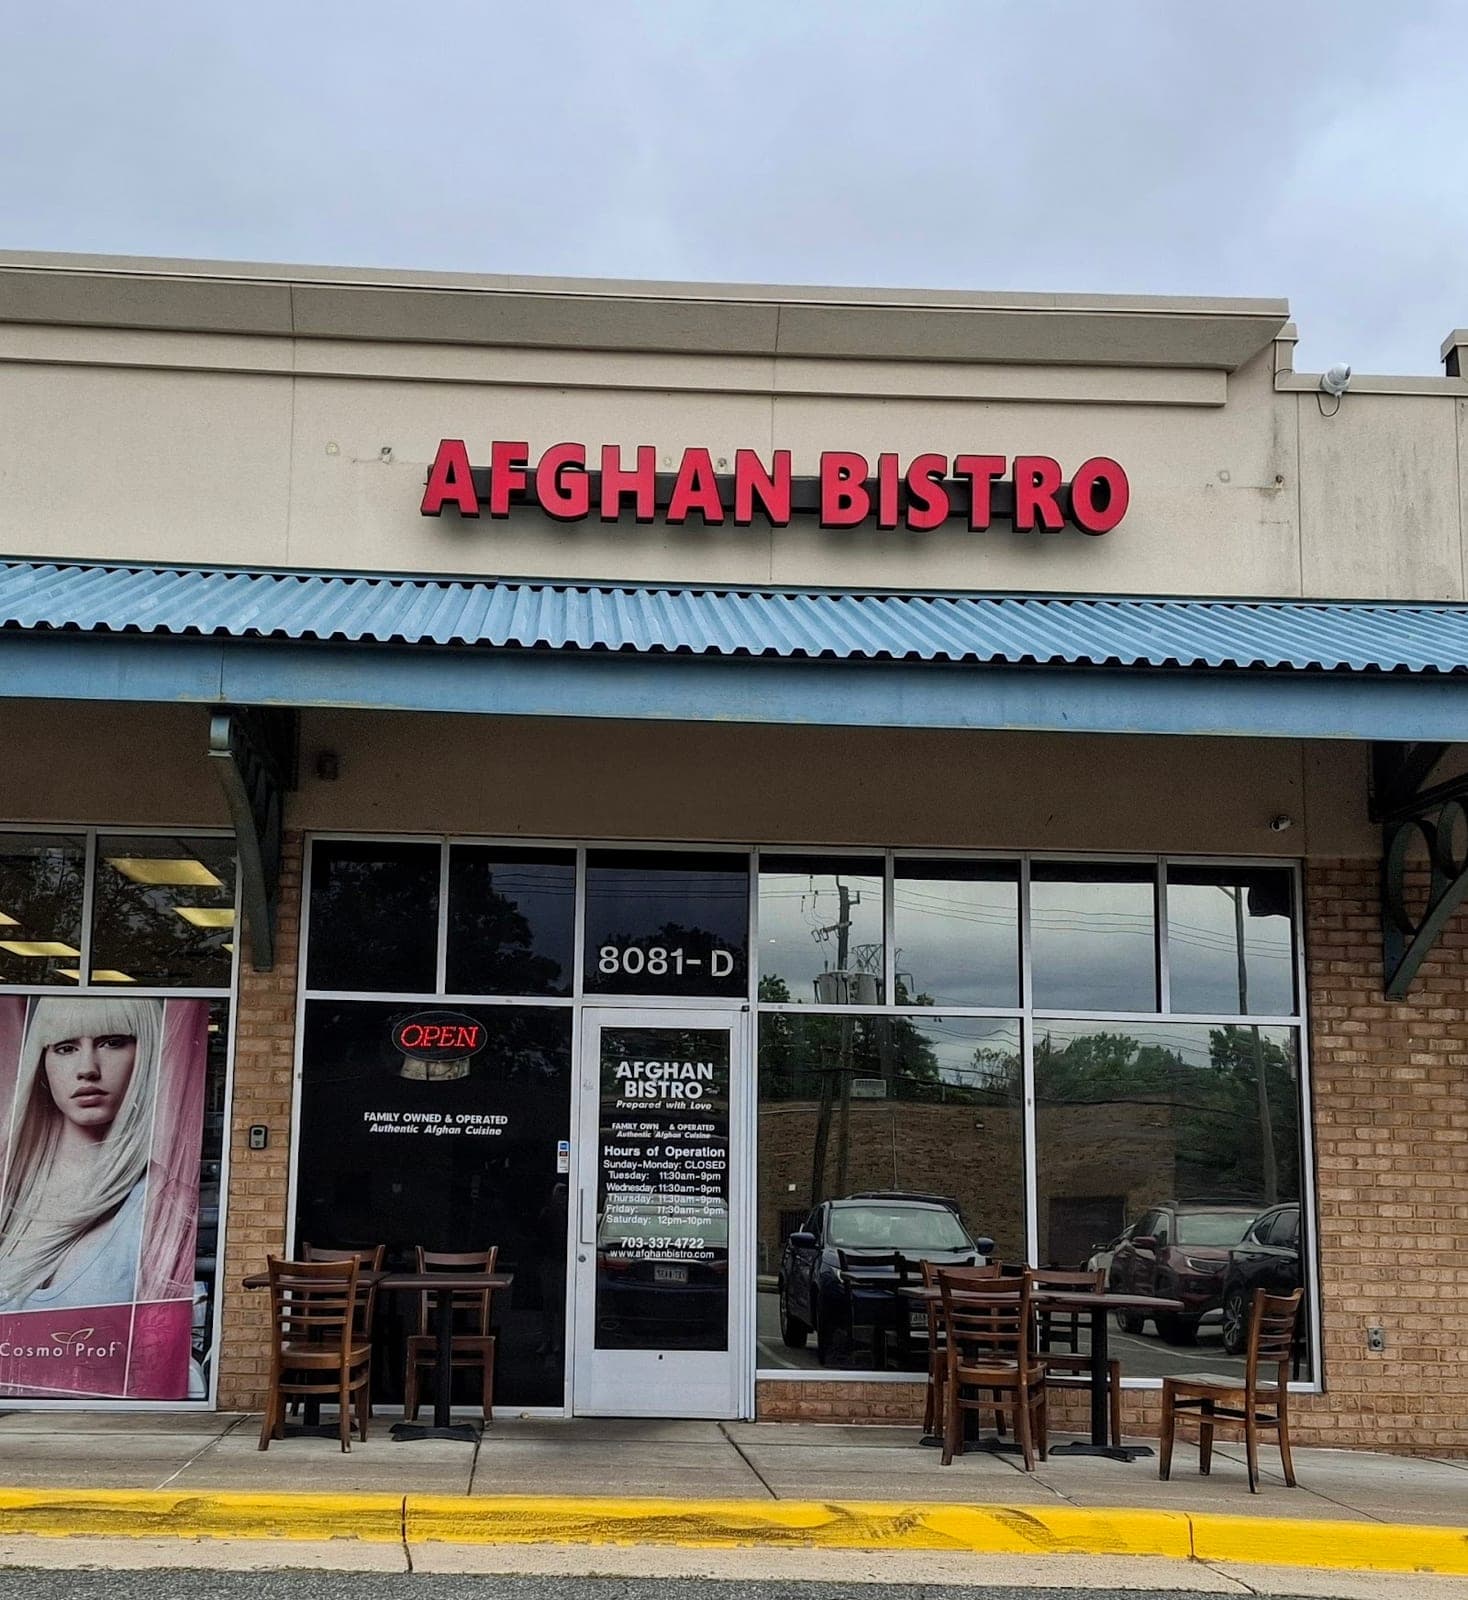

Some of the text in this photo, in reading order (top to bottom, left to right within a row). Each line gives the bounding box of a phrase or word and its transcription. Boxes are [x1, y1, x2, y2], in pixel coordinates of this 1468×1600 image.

[421, 440, 1130, 534] AFGHAN BISTRO
[400, 1024, 479, 1047] OPEN
[616, 1061, 713, 1080] AFGHAN
[625, 1080, 703, 1099] BISTRO
[616, 1100, 712, 1111] Prepared with Love
[364, 1112, 508, 1125] FAMILY OWNED & OPERATED
[369, 1123, 502, 1136] Authentic Afghan Cuisine
[655, 1131, 681, 1139] Afghan
[604, 1146, 725, 1159] Hours of Operation
[684, 1161, 726, 1169] CLOSED
[608, 1171, 649, 1181] Tuesday:
[606, 1183, 657, 1194] Wednesday:
[606, 1205, 639, 1215] Friday:
[607, 1215, 711, 1226] Saturday: 12pm-10pm
[620, 1237, 705, 1249] 703-337-4722
[610, 1249, 715, 1259] www.afghanbistro.com
[0, 1341, 116, 1357] Cosmo Prof
